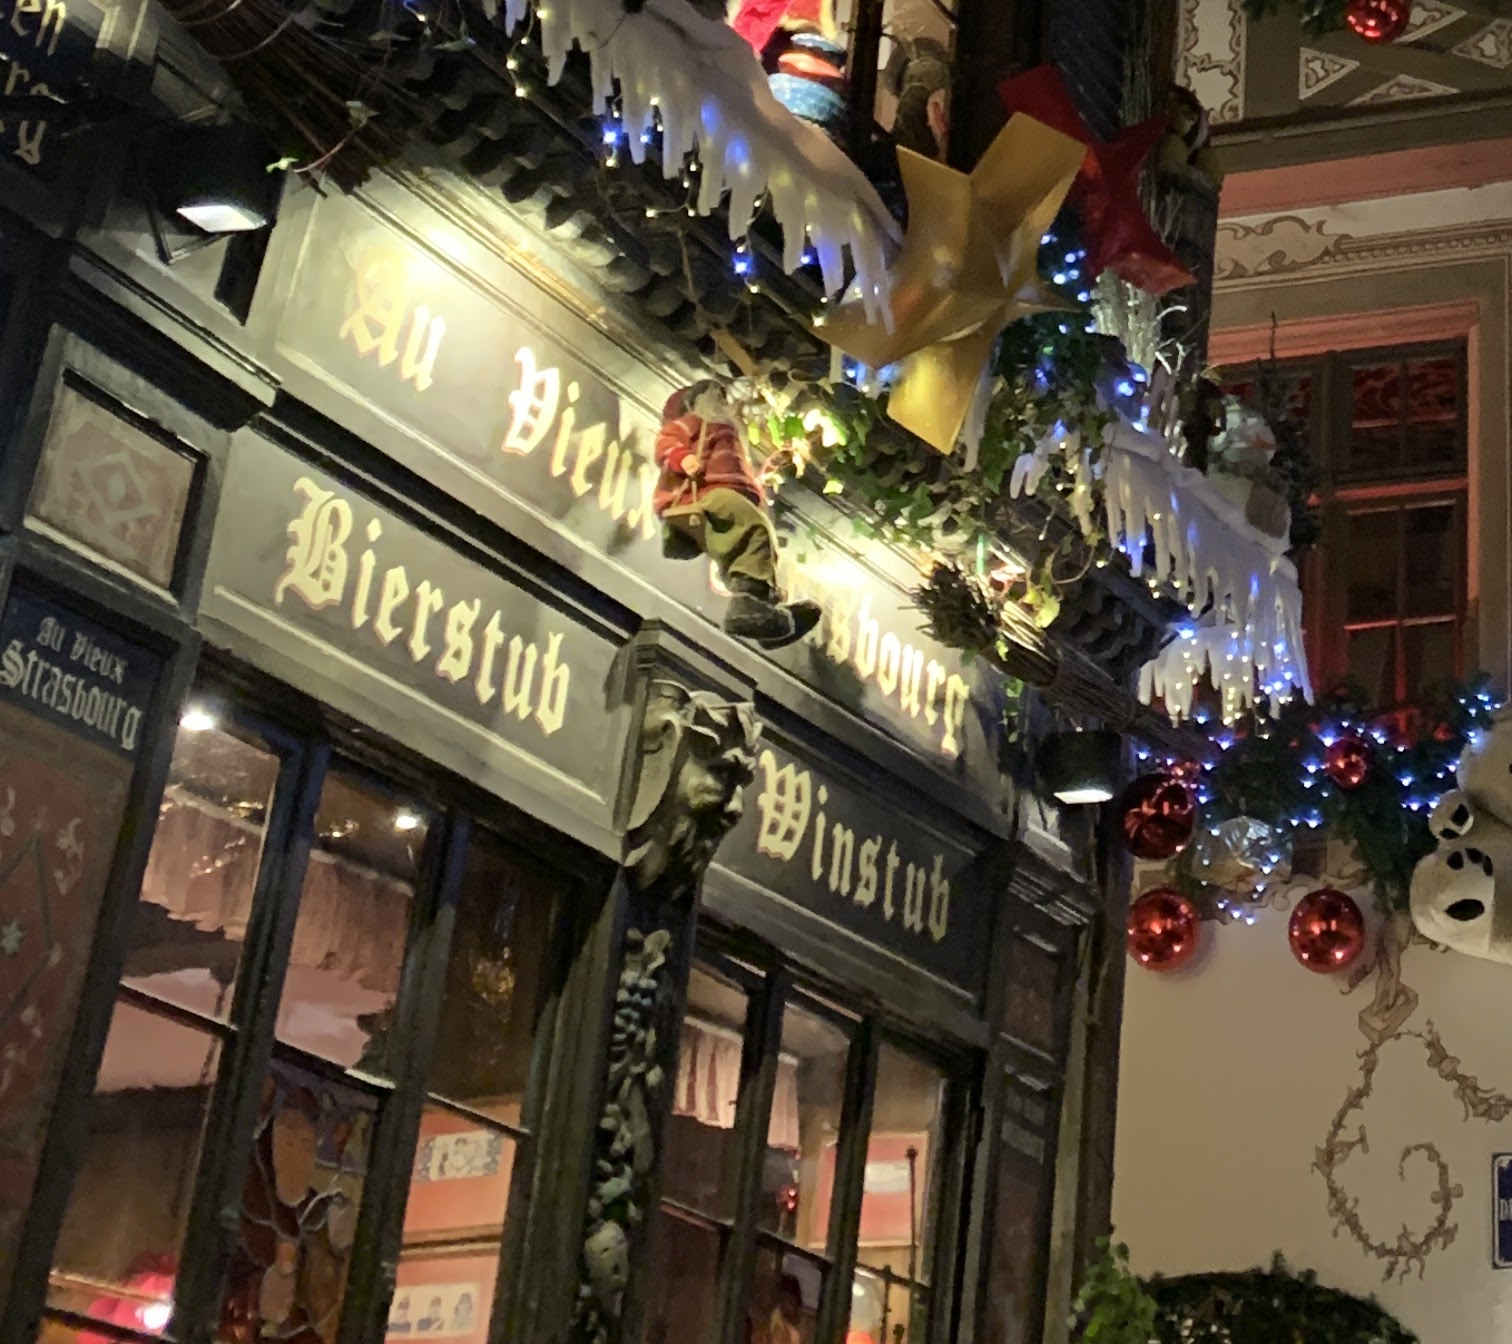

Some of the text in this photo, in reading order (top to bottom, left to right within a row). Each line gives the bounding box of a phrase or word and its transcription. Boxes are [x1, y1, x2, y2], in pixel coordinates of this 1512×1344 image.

[502, 346, 661, 541] Vieux
[274, 476, 571, 736] Bierstub
[757, 749, 951, 944] Winstub
